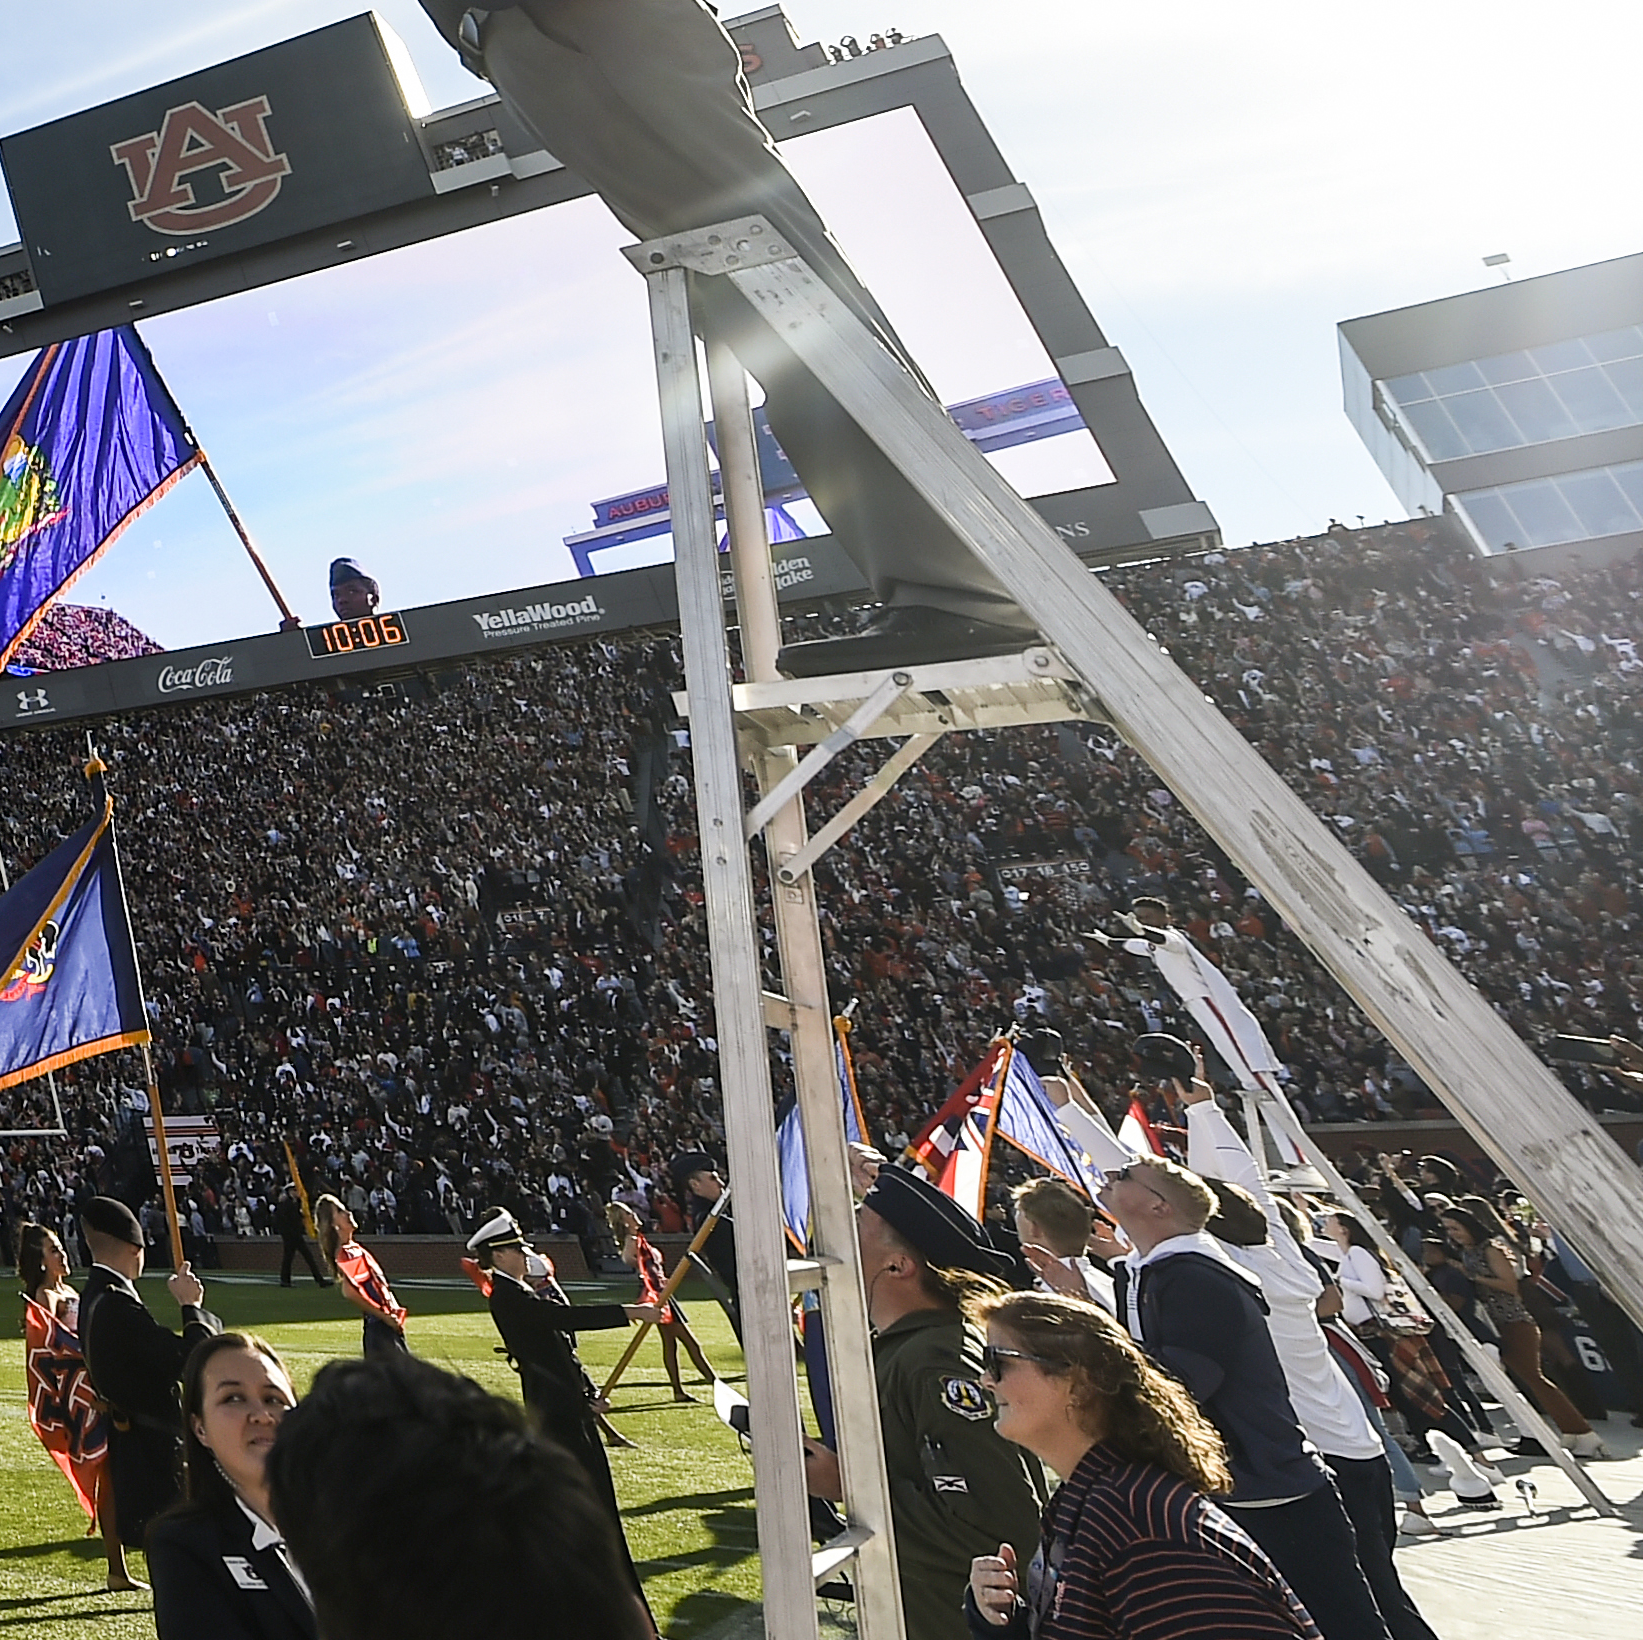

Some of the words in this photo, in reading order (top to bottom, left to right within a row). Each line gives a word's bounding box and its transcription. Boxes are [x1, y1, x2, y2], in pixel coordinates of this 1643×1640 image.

[322, 615, 403, 652] 10:06
[483, 626, 530, 639] Pressure
[533, 617, 574, 631] Treated
[576, 613, 601, 625] Pine
